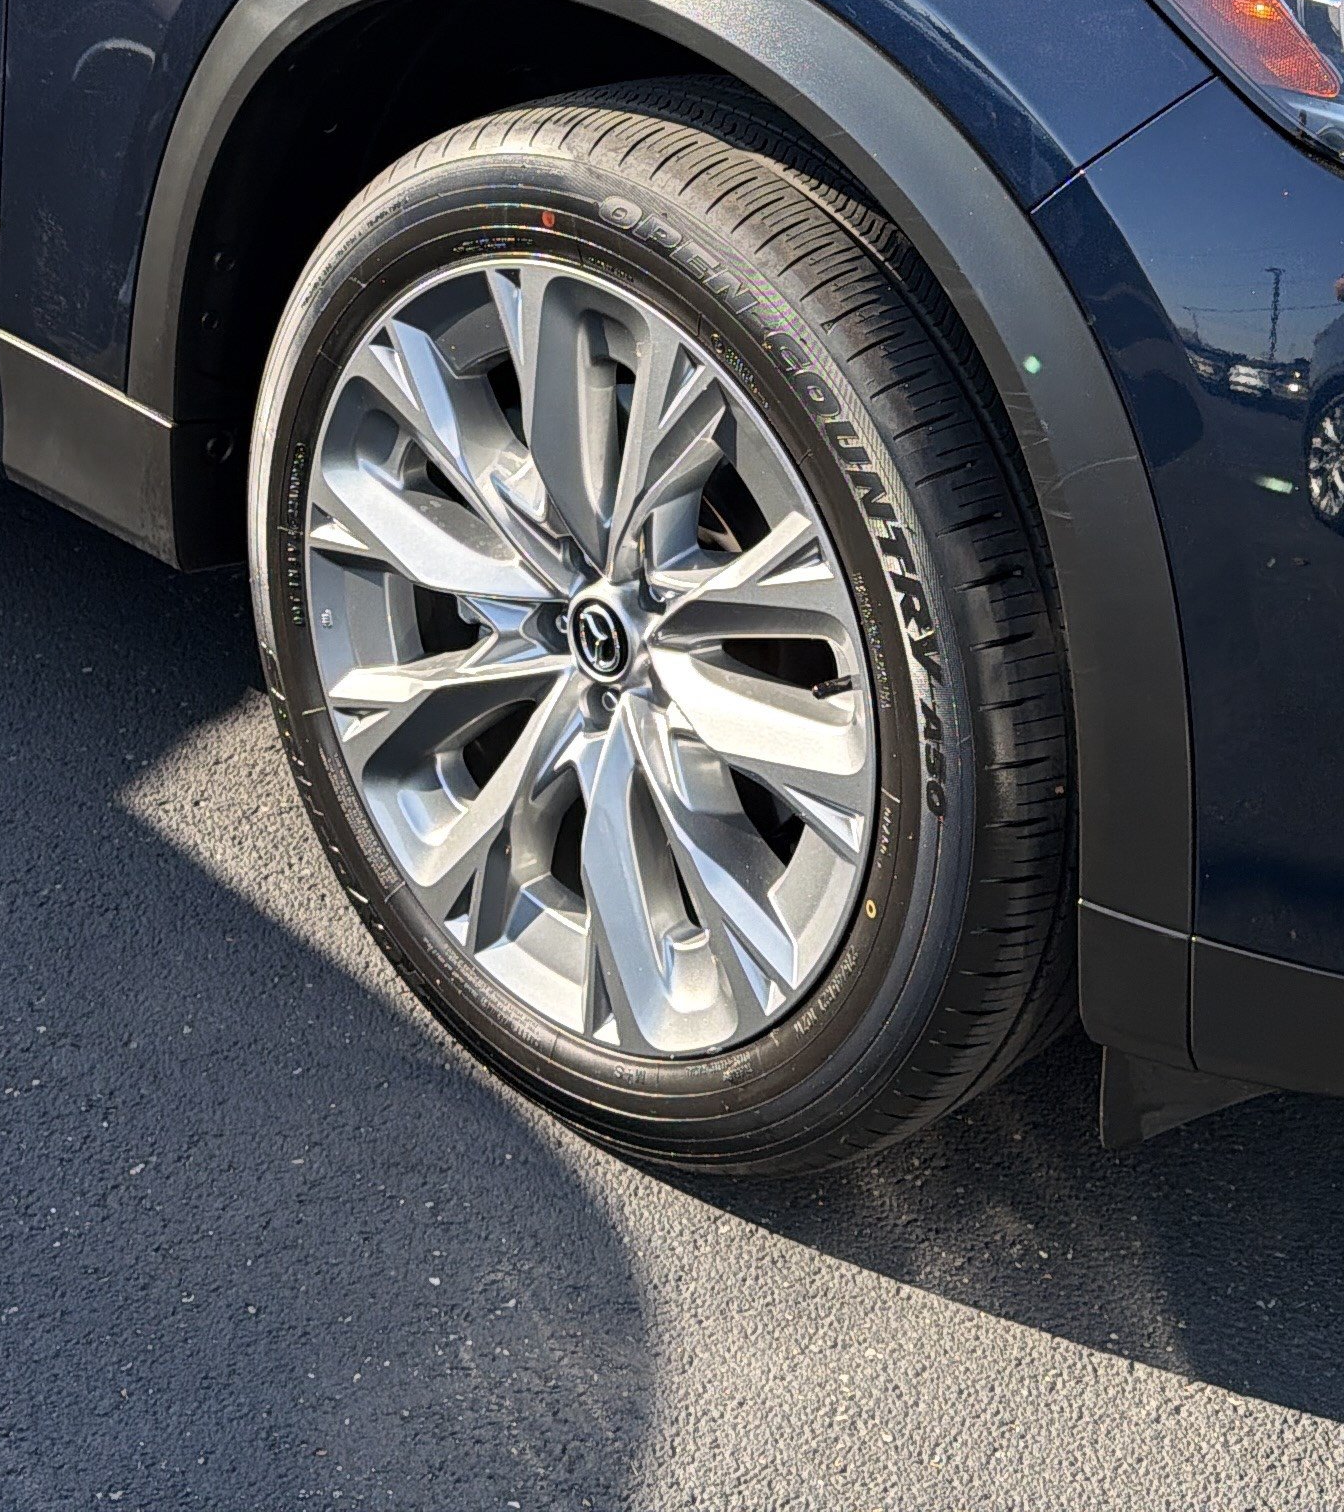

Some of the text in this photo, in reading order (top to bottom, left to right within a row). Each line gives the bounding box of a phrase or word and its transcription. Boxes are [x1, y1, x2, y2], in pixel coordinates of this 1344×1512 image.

[598, 195, 948, 816] OPEN COUNTRY A50
